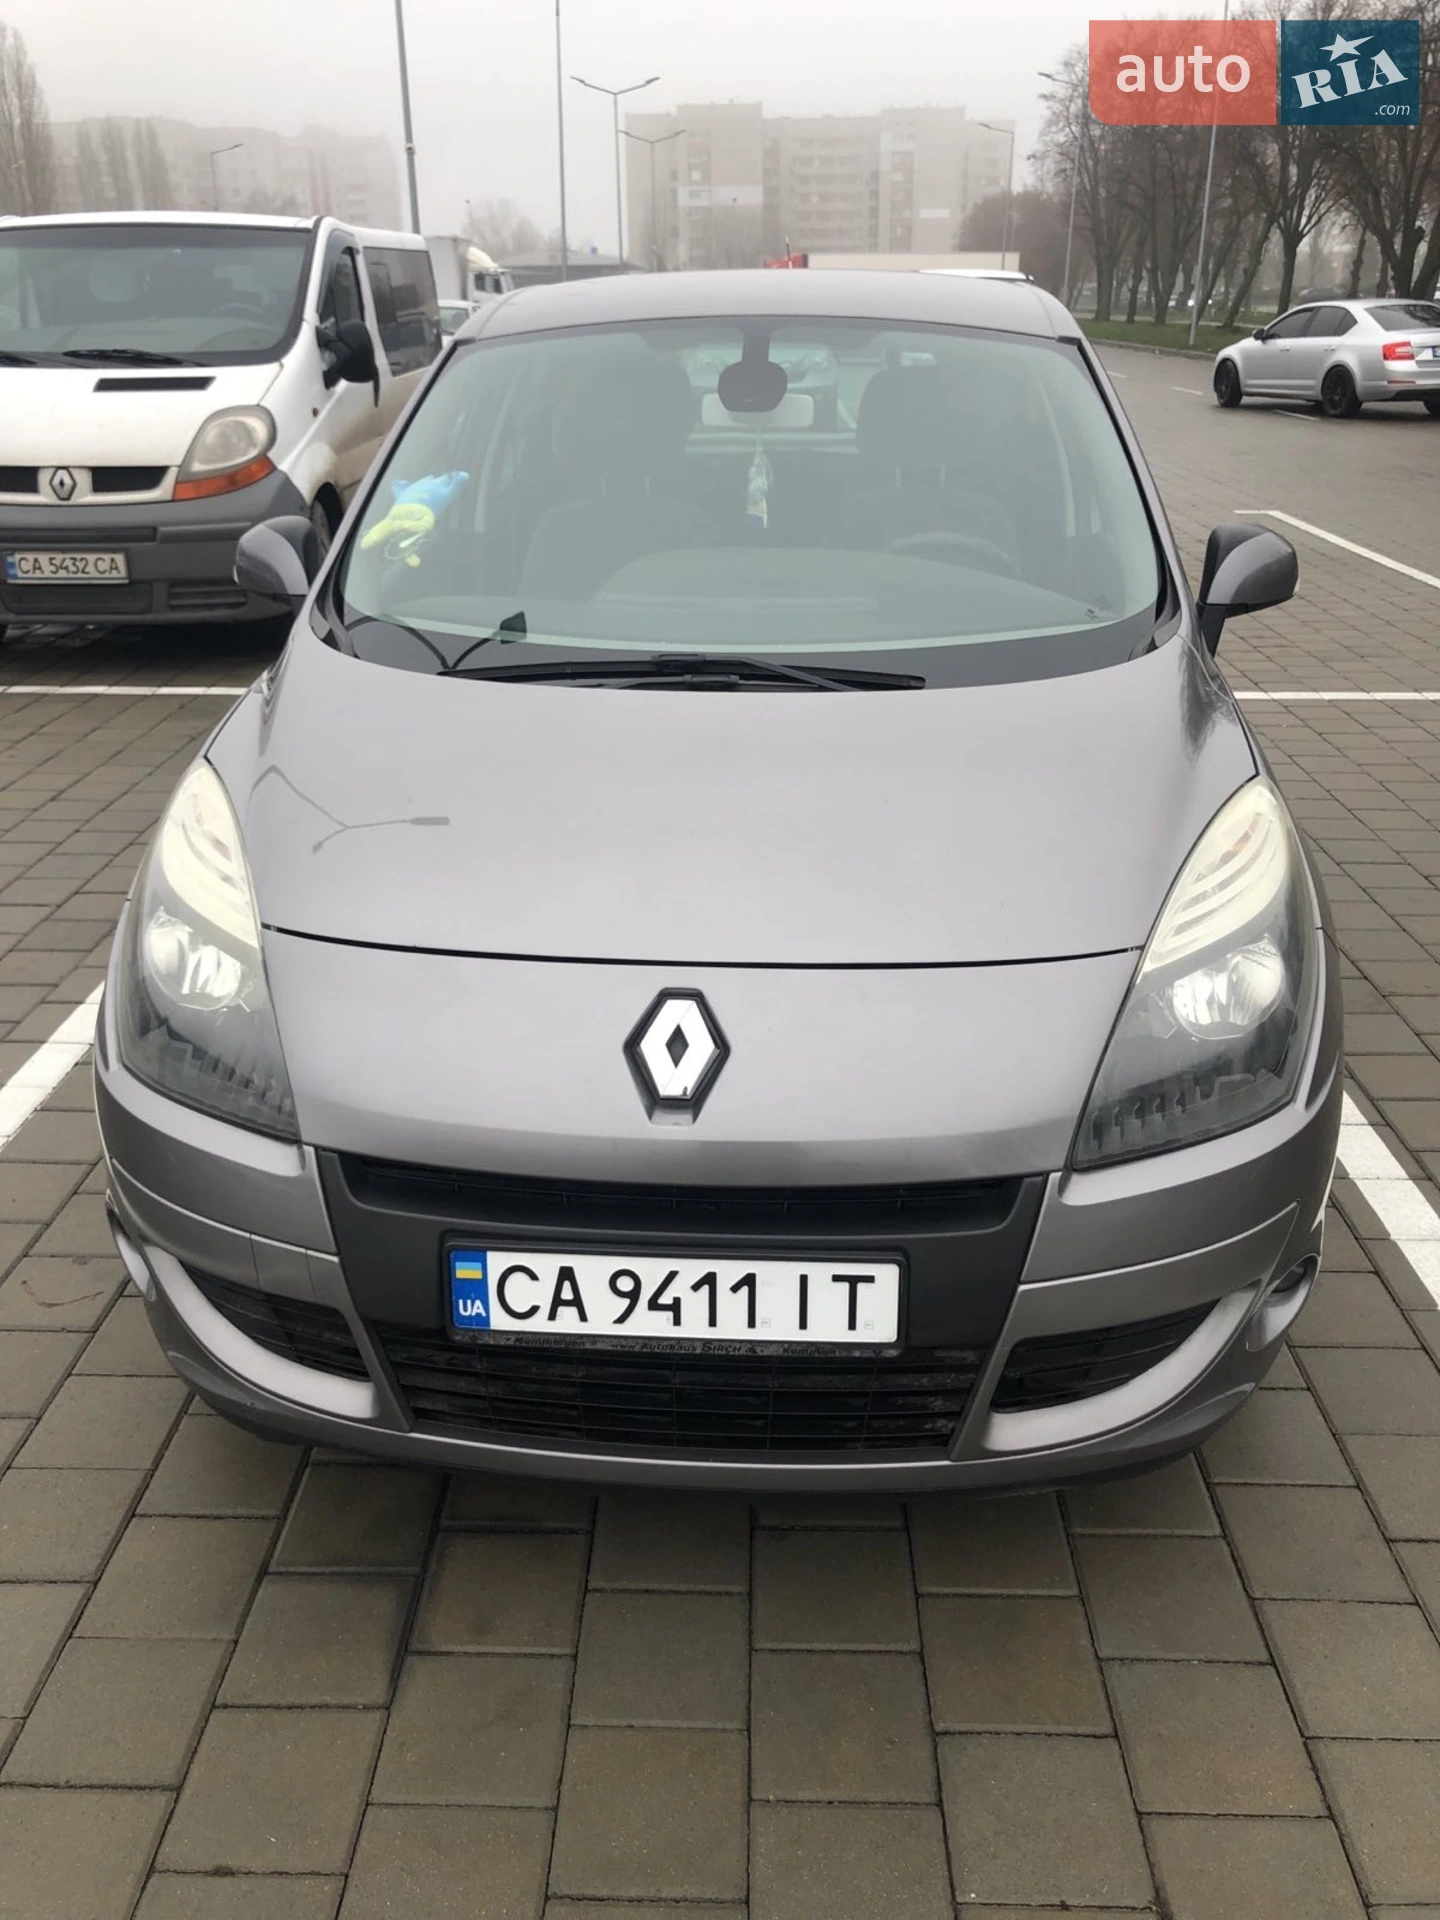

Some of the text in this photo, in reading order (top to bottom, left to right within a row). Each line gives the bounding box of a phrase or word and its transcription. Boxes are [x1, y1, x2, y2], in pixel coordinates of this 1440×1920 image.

[17, 556, 45, 575] CA
[48, 556, 91, 575] 5432
[94, 556, 121, 575] CA
[496, 1264, 876, 1331] CA 9411 IT
[458, 1299, 487, 1317] UA
